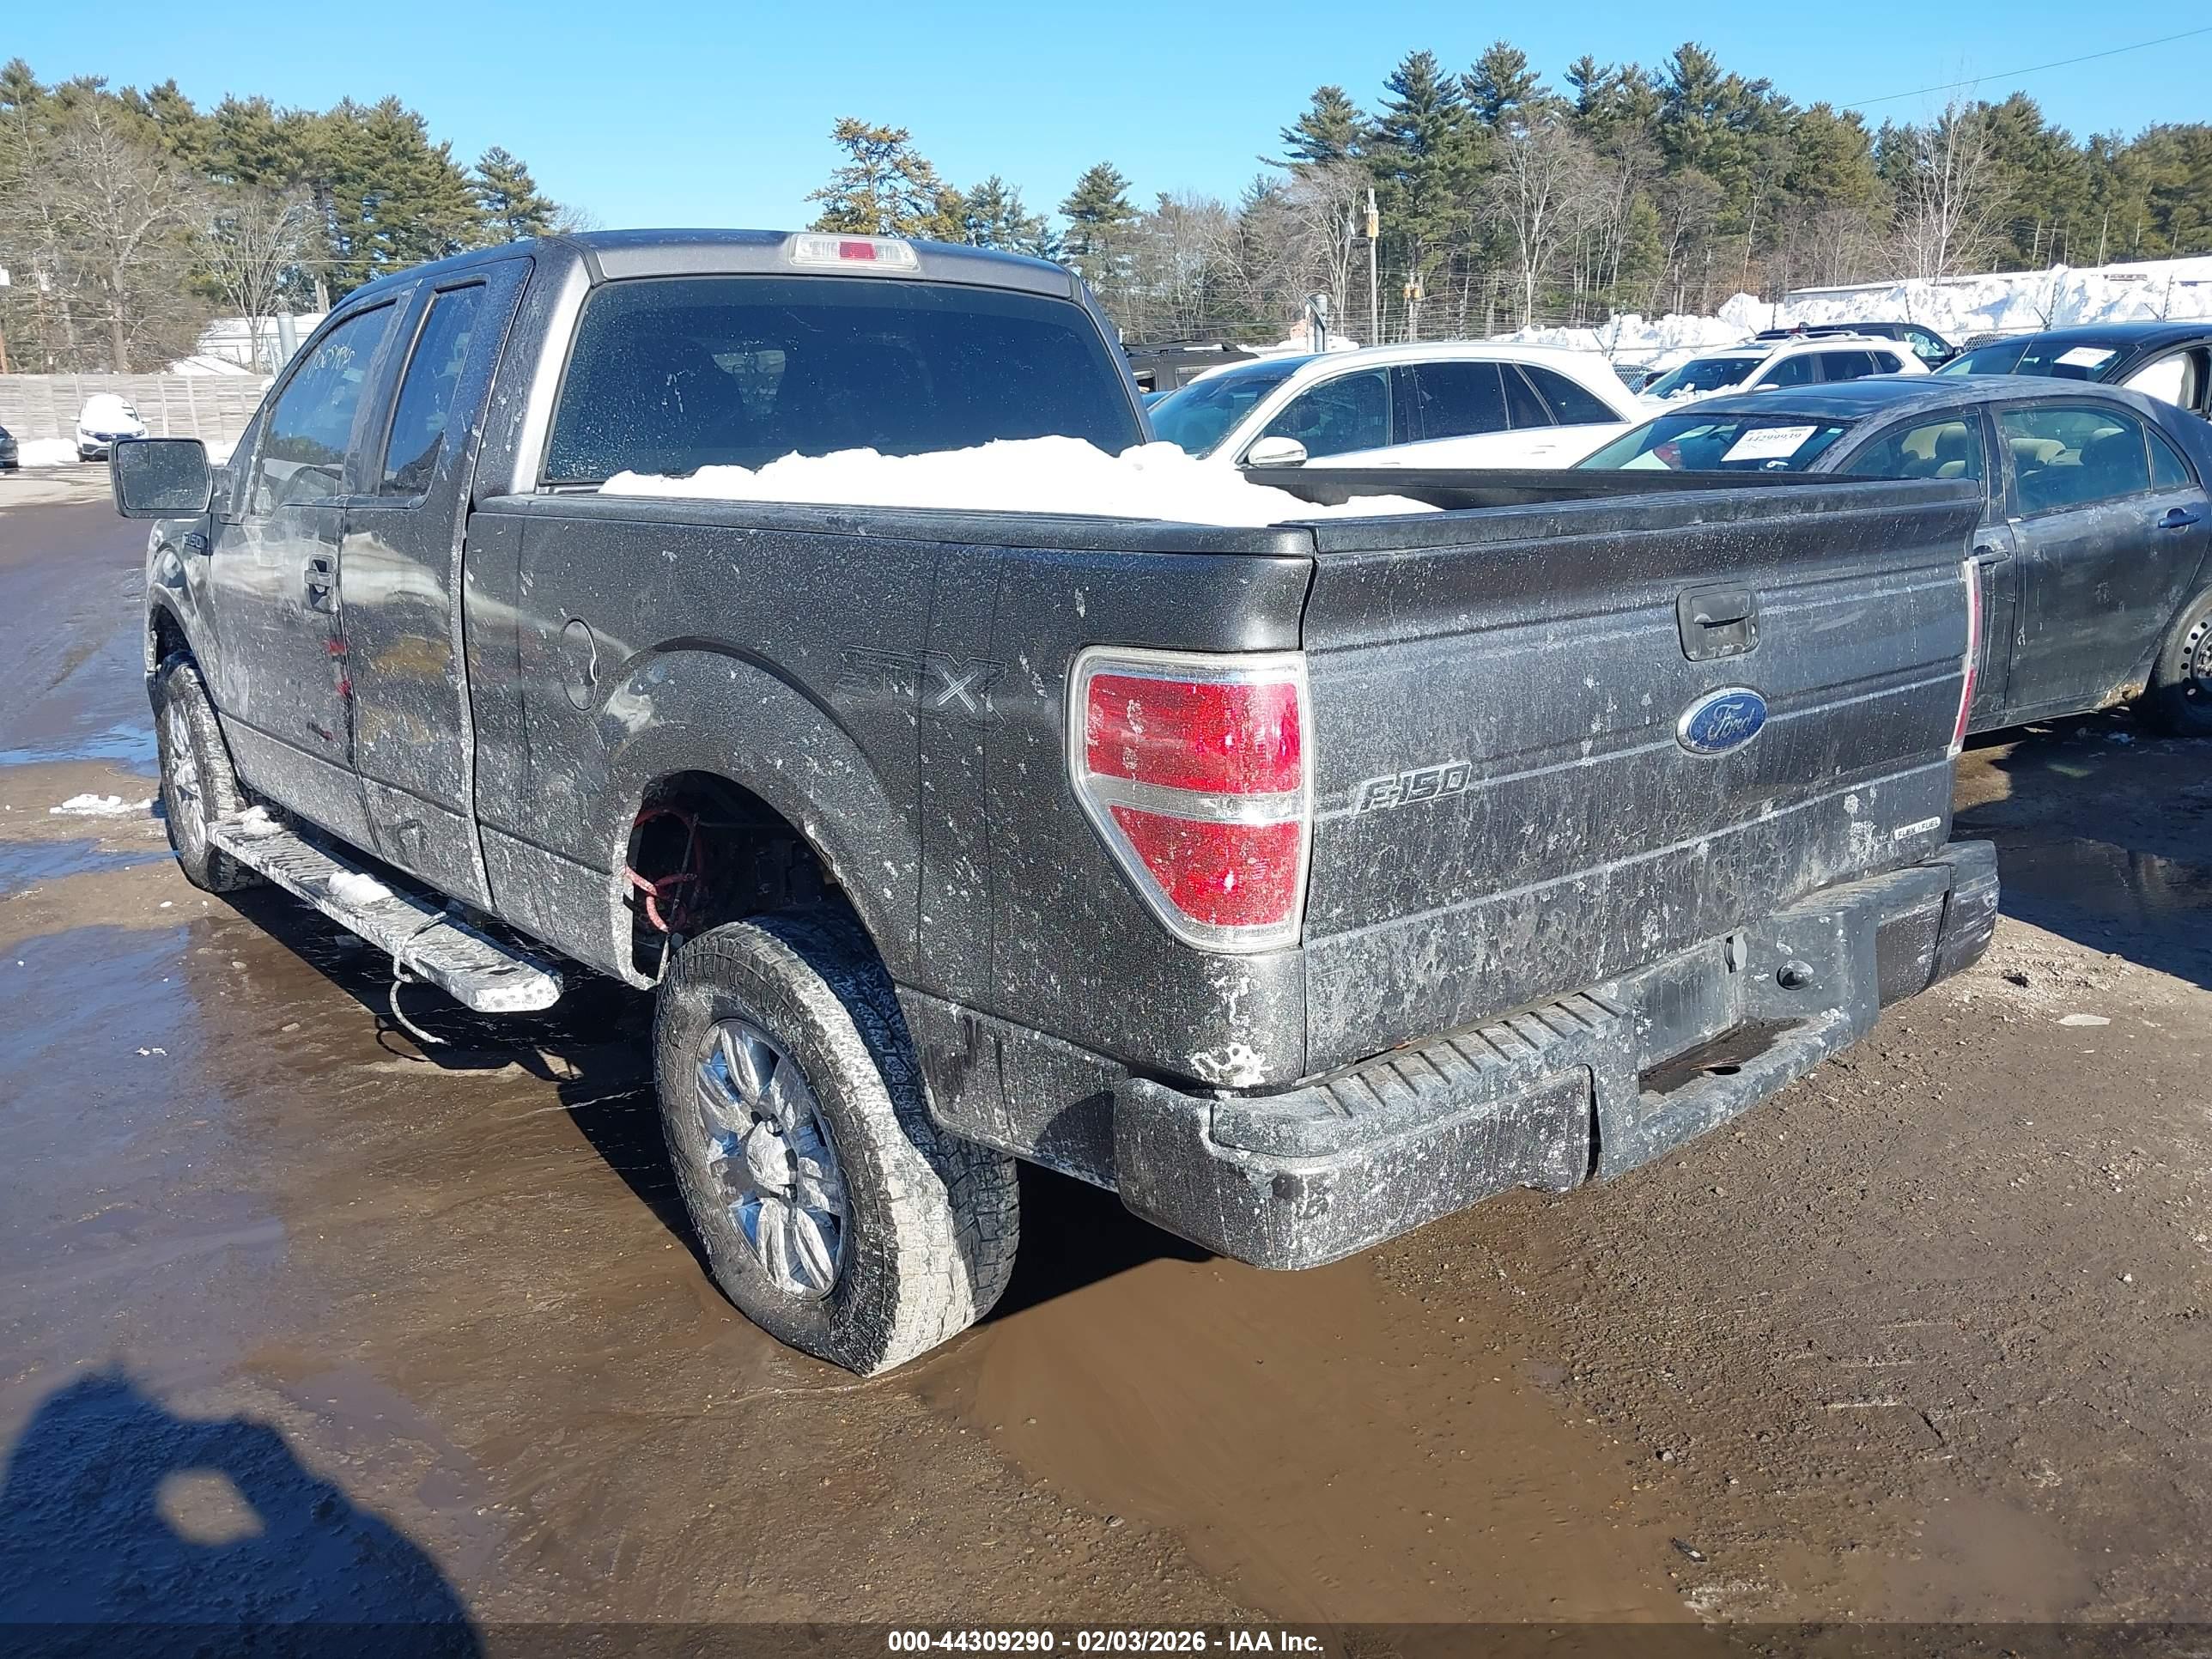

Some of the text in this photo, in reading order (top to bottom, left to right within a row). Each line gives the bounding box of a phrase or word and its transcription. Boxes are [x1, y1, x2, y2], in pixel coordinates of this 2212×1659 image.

[1707, 702, 1756, 742] Ford
[1898, 819, 1939, 839] FLEX FUEL
